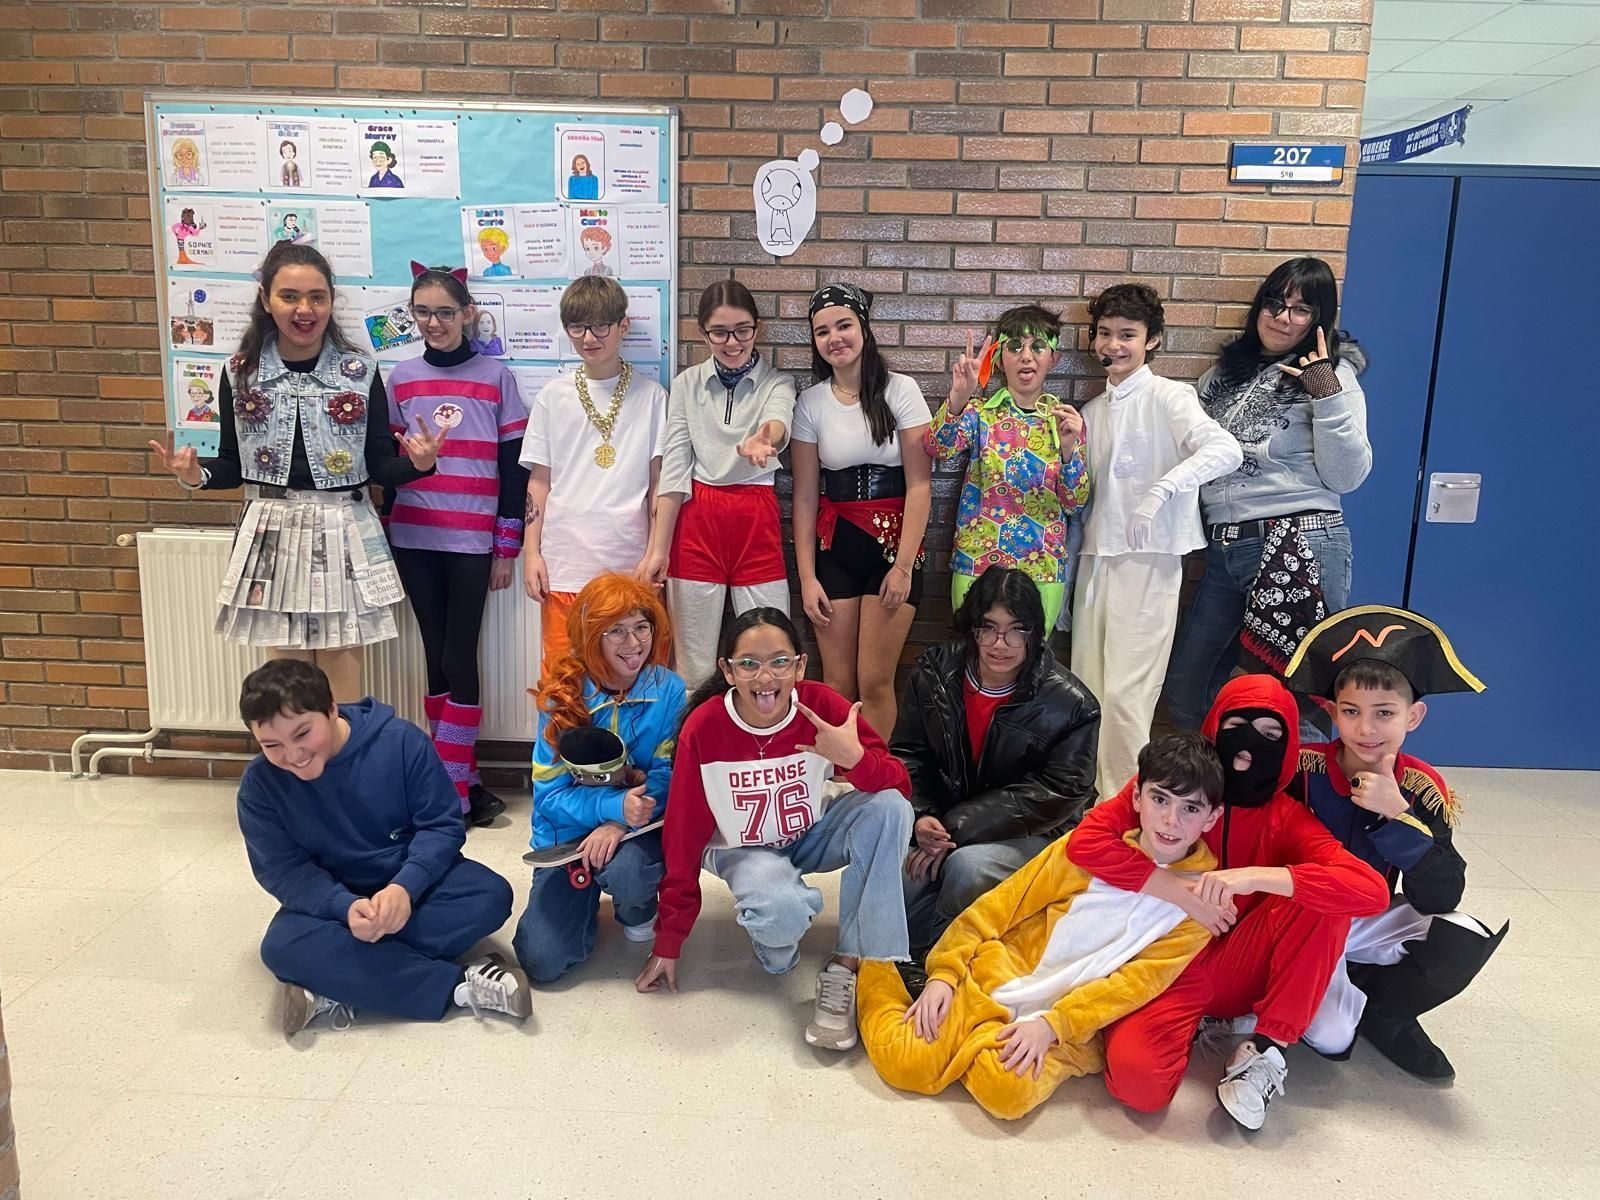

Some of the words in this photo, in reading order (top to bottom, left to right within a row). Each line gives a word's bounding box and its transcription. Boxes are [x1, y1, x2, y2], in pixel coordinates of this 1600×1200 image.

[364, 133, 397, 141] Murray
[1273, 147, 1312, 165] 207
[1362, 139, 1392, 156] OURENSE
[478, 219, 504, 227] Curie
[728, 759, 807, 788] DEFENSE
[732, 779, 815, 845] 76
